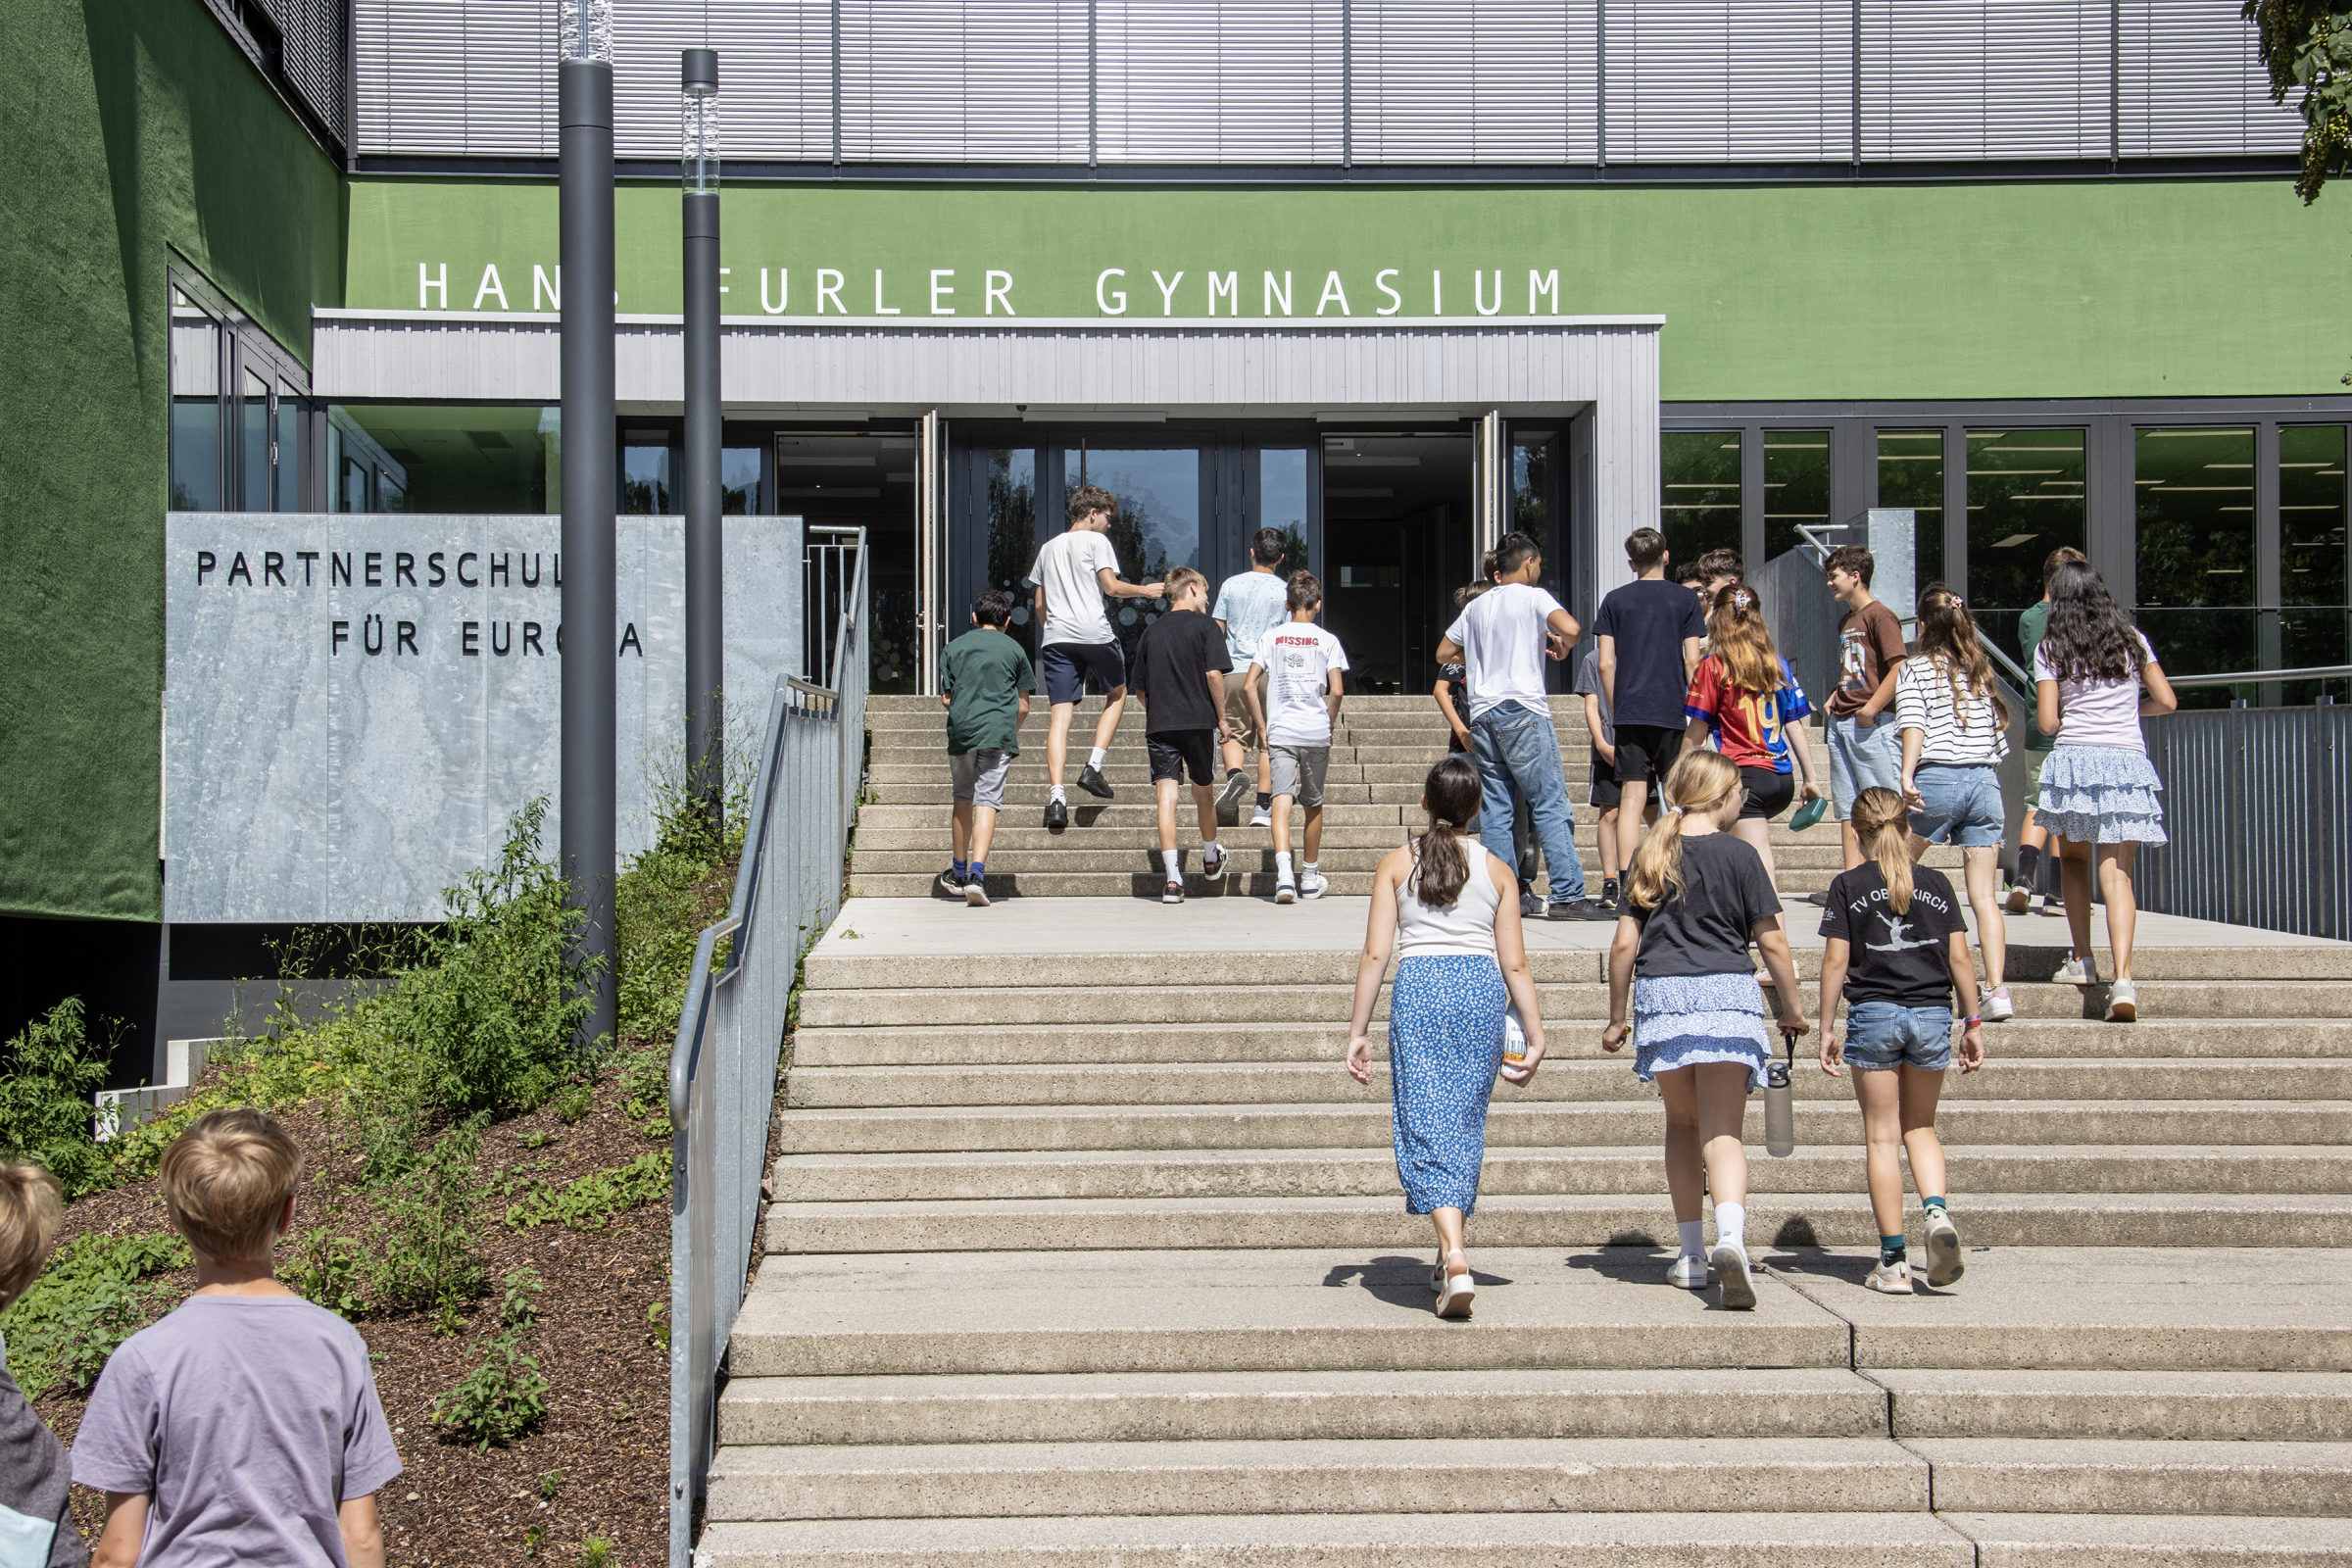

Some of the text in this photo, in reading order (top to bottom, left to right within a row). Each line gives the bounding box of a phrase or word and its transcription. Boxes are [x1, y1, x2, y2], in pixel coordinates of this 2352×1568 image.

[418, 263, 1559, 317] HAN URLER GYMNASIUM
[196, 550, 562, 588] PARTNERSCHUL
[331, 613, 643, 658] FÜR EURA
[1275, 635, 1319, 647] MISSING
[1738, 692, 1781, 745] 19
[1849, 896, 1869, 914] TV
[1870, 888, 1949, 914] OBKIRCH
